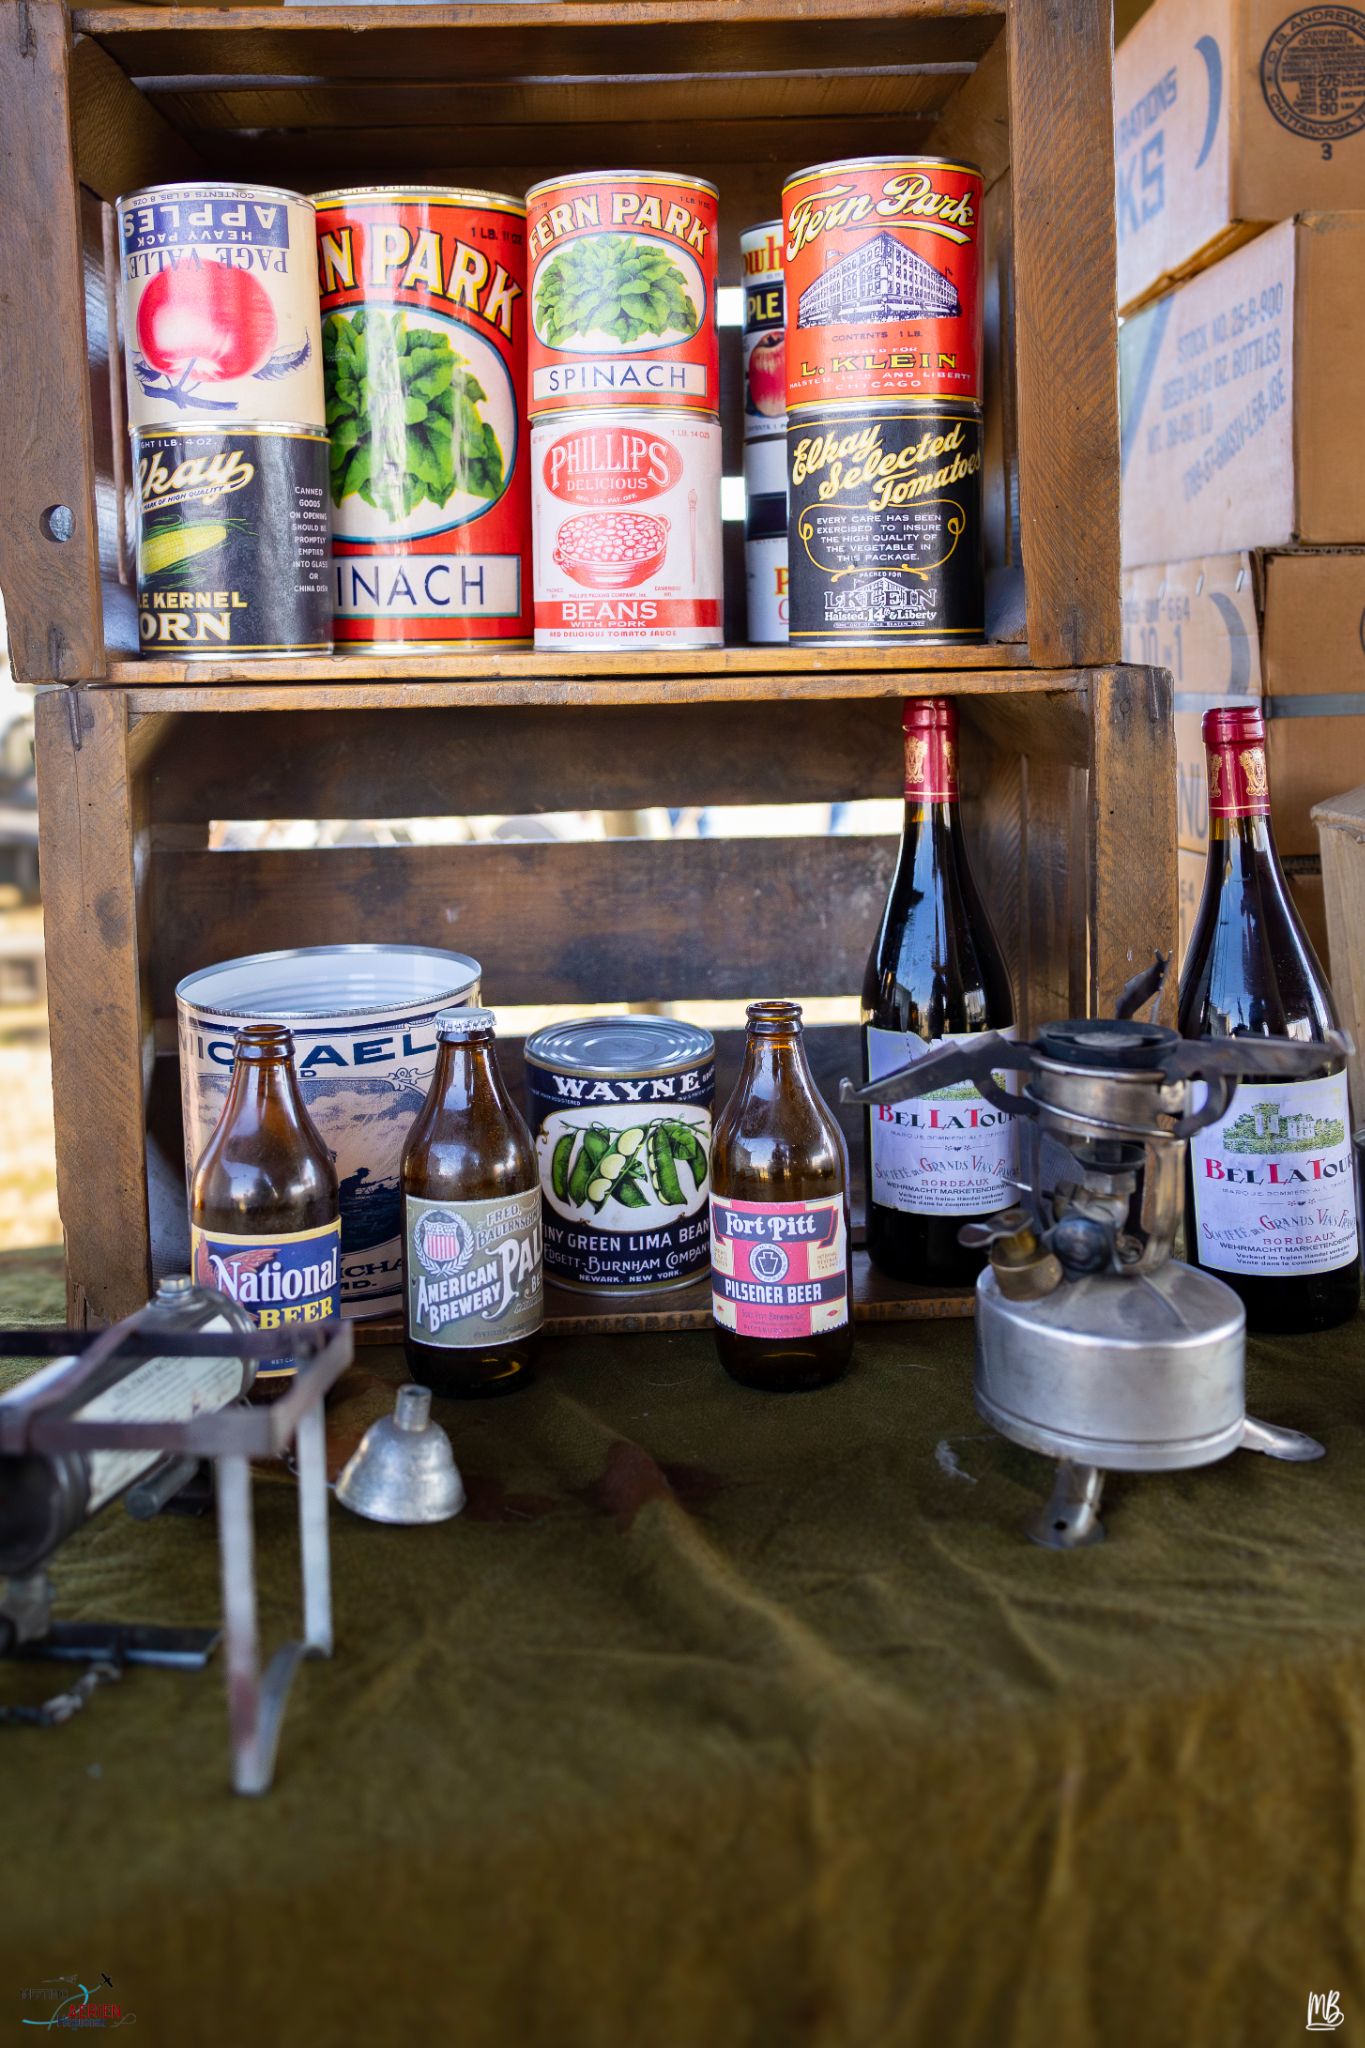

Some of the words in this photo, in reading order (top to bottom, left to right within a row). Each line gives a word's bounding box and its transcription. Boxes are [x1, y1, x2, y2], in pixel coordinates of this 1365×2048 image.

[1319, 88, 1338, 101] 90
[1319, 103, 1338, 115] 90
[1321, 144, 1333, 160] 3
[195, 191, 255, 199] CONTENTS
[123, 202, 277, 238] APPLES
[786, 184, 876, 262] Fern
[876, 172, 975, 228] Park
[529, 192, 601, 263] FERN
[610, 191, 711, 259] PARK
[137, 233, 178, 247] PACK
[187, 230, 252, 242] HEAVY
[215, 247, 288, 274] PAGE
[368, 222, 523, 340] PARK
[832, 331, 888, 342] CONTENTS
[1232, 327, 1281, 379] BOTTLES
[801, 361, 825, 378] L.
[832, 353, 957, 373] KLEIN
[549, 365, 686, 391] SPINACH
[835, 380, 922, 391] CHICAGO
[551, 434, 670, 490] PHILLIPS
[792, 424, 884, 485] Elkay
[818, 422, 966, 501] Selected
[139, 451, 255, 506] lkay
[566, 477, 649, 492] DELICIOUS
[869, 449, 981, 513] Tomatoes
[189, 486, 225, 497] QUALITY
[295, 486, 323, 496] CANNED
[299, 499, 321, 508] GOODS
[289, 511, 301, 519] ON
[816, 516, 847, 525] EVERY
[851, 514, 882, 523] CARE
[886, 513, 910, 522] HAS
[914, 513, 942, 522] BEEN
[816, 524, 873, 534] EXERCISED
[880, 524, 896, 532] TO
[903, 524, 942, 532] INSURE
[294, 536, 327, 544] PROMPTLY
[820, 535, 840, 544] THE
[842, 534, 869, 544] HIGH
[872, 533, 920, 542] QUALITY
[923, 533, 937, 541] OF
[298, 548, 324, 556] EMPTIED
[826, 545, 845, 553] THE
[850, 543, 914, 552] VEGETABLE
[837, 554, 860, 562] THIS
[865, 552, 920, 561] PACKAGE.
[308, 572, 319, 580] OR
[294, 584, 315, 593] CHINA
[336, 565, 485, 607] INACH
[153, 591, 248, 609] KERNEL
[562, 602, 658, 621] BEANS
[897, 609, 938, 621] Liberty
[140, 612, 231, 641] ORN
[608, 620, 647, 628] PORK
[563, 630, 605, 638] DELICIOUS
[552, 1070, 700, 1101] WAYNE
[920, 1158, 969, 1174] GRANDS
[887, 1181, 938, 1194] WEHRMACHT
[921, 1178, 990, 1187] BORDEAUX
[725, 1211, 766, 1236] Fort
[767, 1214, 816, 1241] Pitt
[1260, 1214, 1314, 1231] GRANDS
[567, 1233, 621, 1251] GREEN
[629, 1229, 673, 1252] LIMA
[679, 1216, 711, 1243] BEAN
[1263, 1231, 1336, 1245] BORDEAUX
[1219, 1241, 1282, 1253] WEHRMACHT
[543, 1242, 661, 1273] EDGETT-BURNHAM
[1236, 1252, 1266, 1260] Verkauf
[1304, 1250, 1328, 1259] Handel
[209, 1246, 338, 1302] National
[481, 1227, 543, 1320] PAL
[629, 1273, 652, 1283] NEW
[657, 1269, 683, 1279] YORK.
[416, 1261, 499, 1324] AMERICAN
[725, 1279, 783, 1304] PILSENER
[787, 1283, 822, 1304] BEER
[257, 1296, 334, 1331] BEER
[429, 1283, 503, 1333] BREWERY
